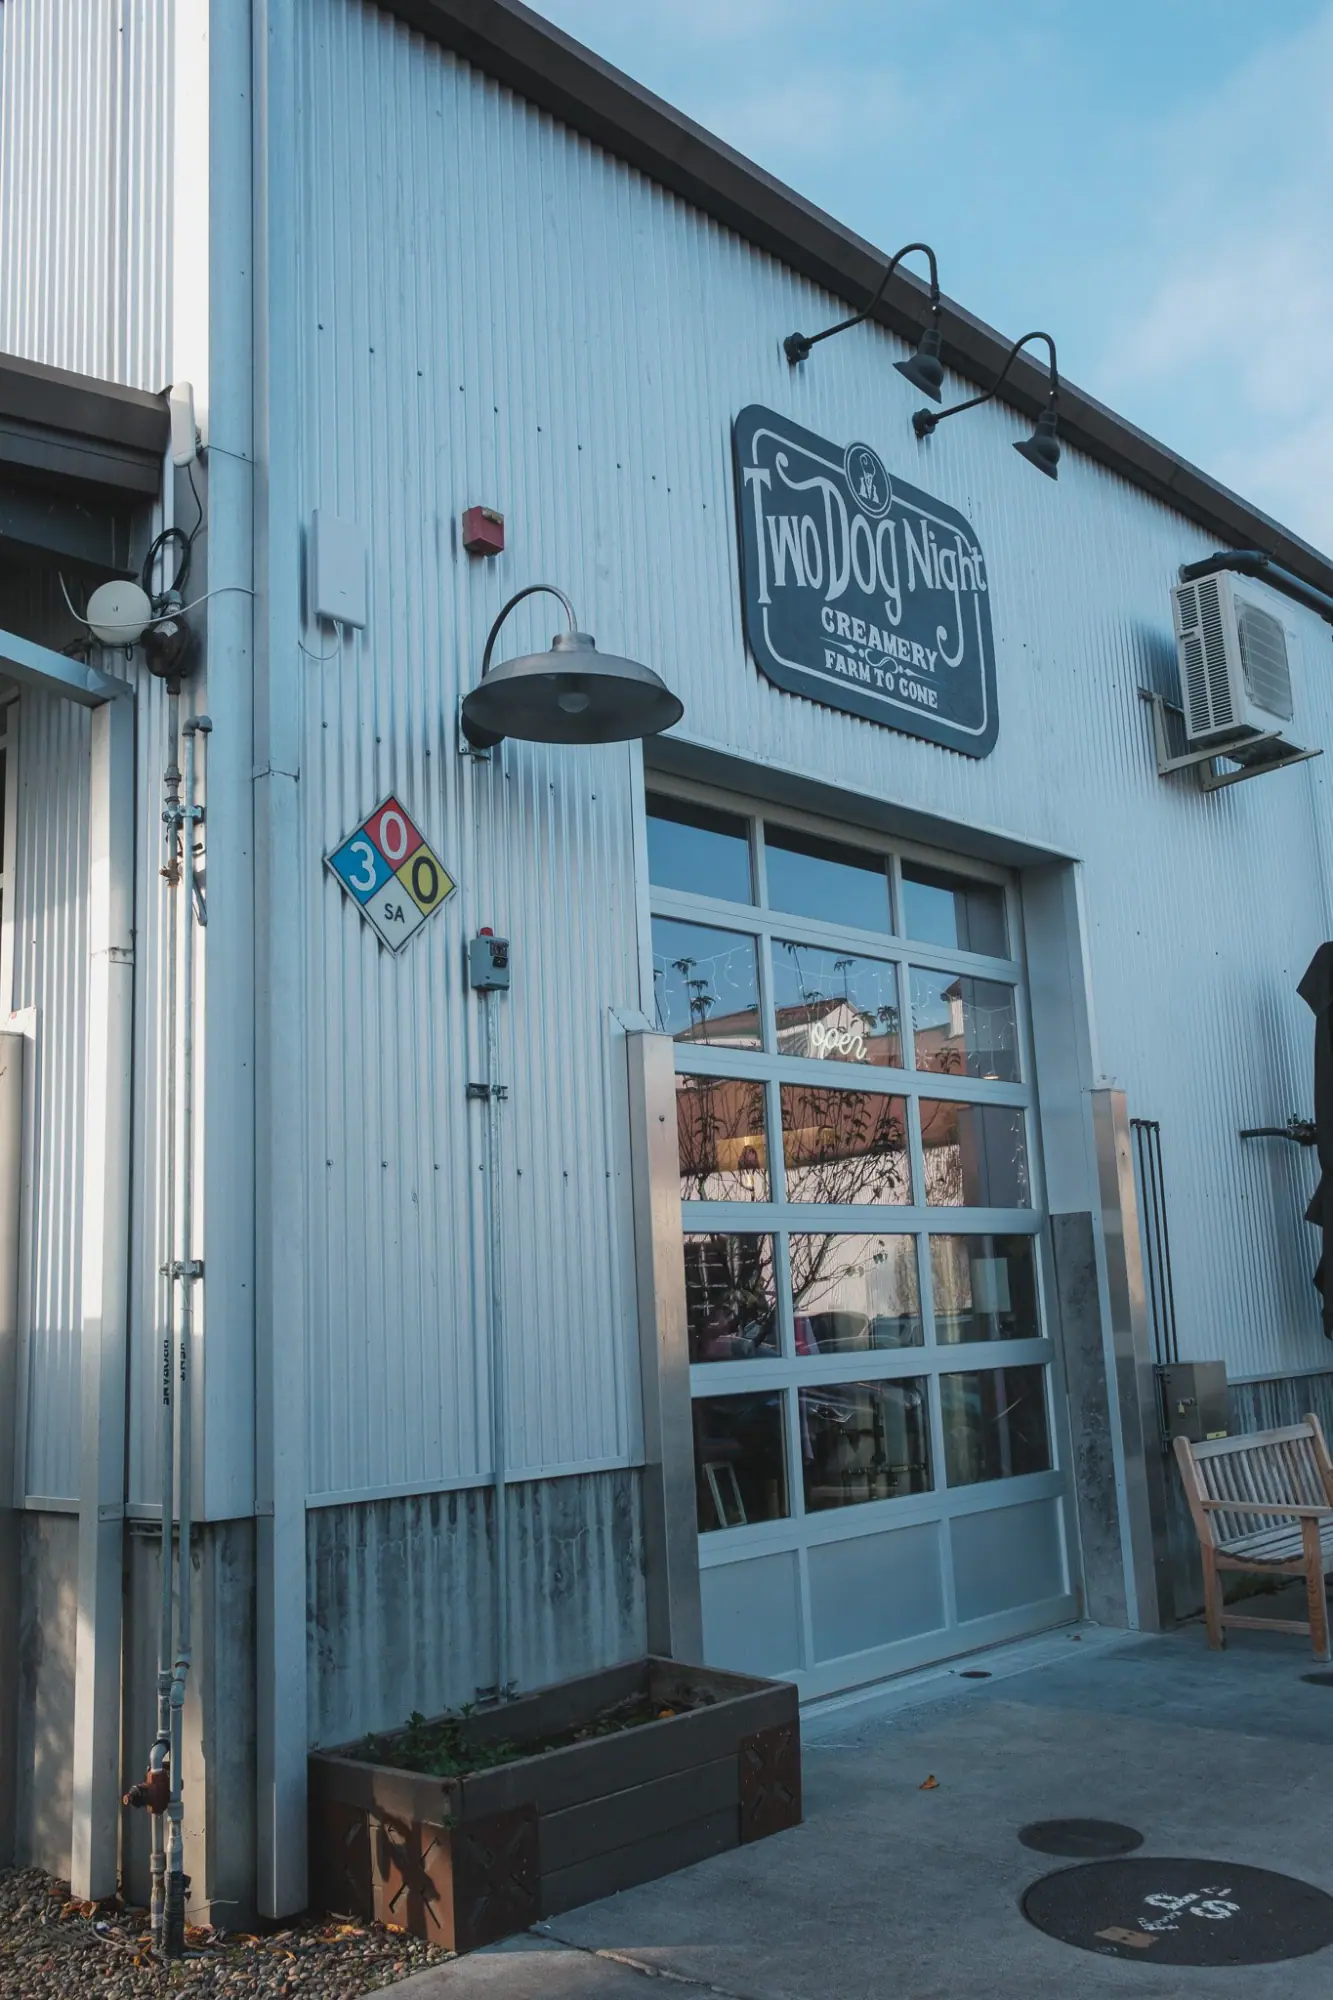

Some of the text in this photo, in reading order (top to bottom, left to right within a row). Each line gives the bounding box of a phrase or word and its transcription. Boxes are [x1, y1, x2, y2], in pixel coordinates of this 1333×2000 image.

[902, 517, 988, 668] Night
[820, 605, 939, 673] CREAMERY
[824, 648, 939, 710] FARM TO CONE
[379, 810, 408, 860] 0
[349, 841, 377, 892] 3
[411, 855, 439, 904] 0
[384, 902, 406, 924] SA
